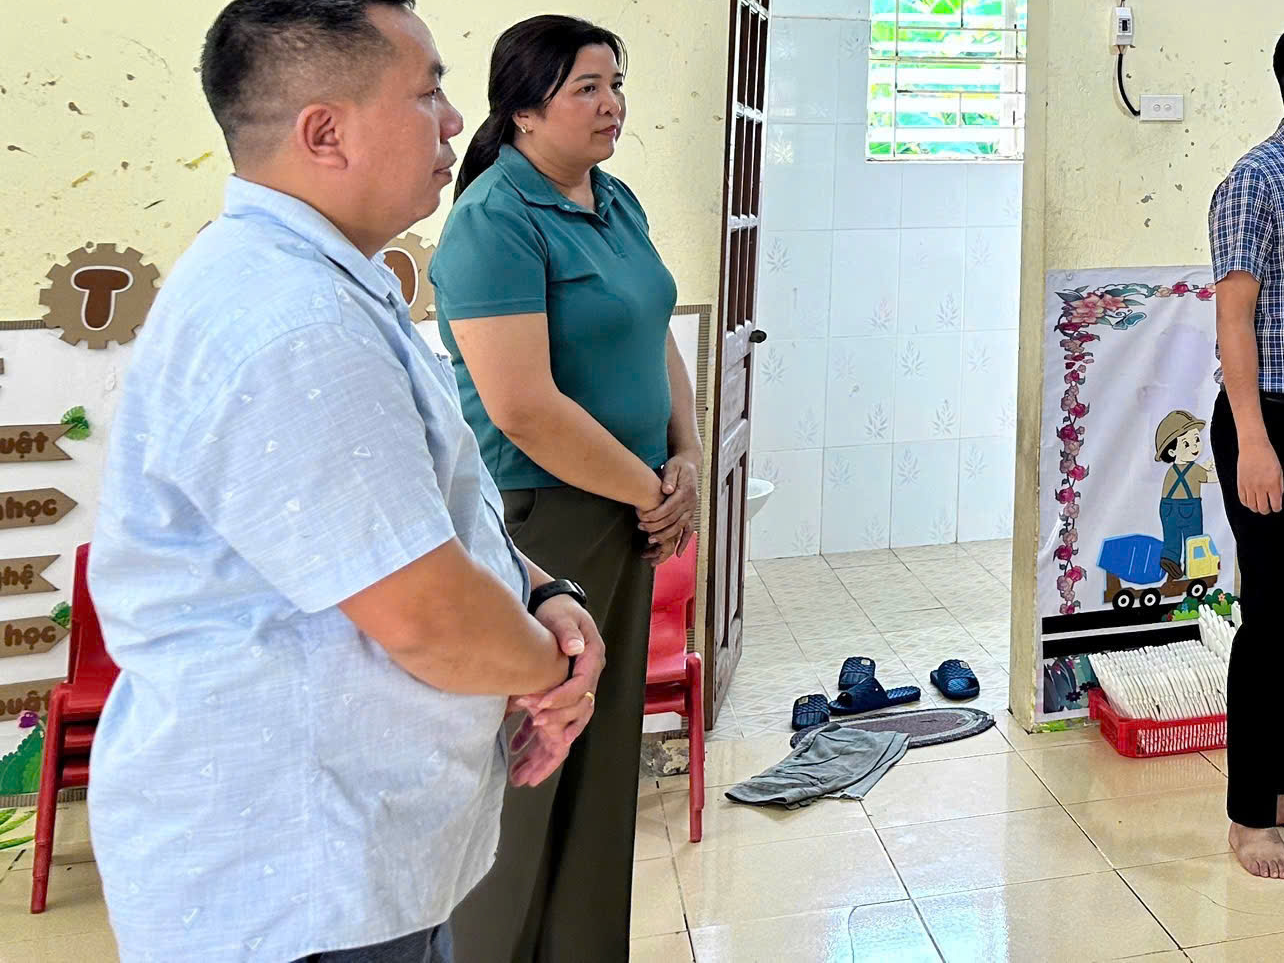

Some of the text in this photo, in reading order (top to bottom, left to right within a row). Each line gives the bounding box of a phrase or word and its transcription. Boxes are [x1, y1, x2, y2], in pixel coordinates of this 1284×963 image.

[0, 431, 49, 459] uật
[0, 563, 34, 590] hệ
[4, 623, 56, 650] học
